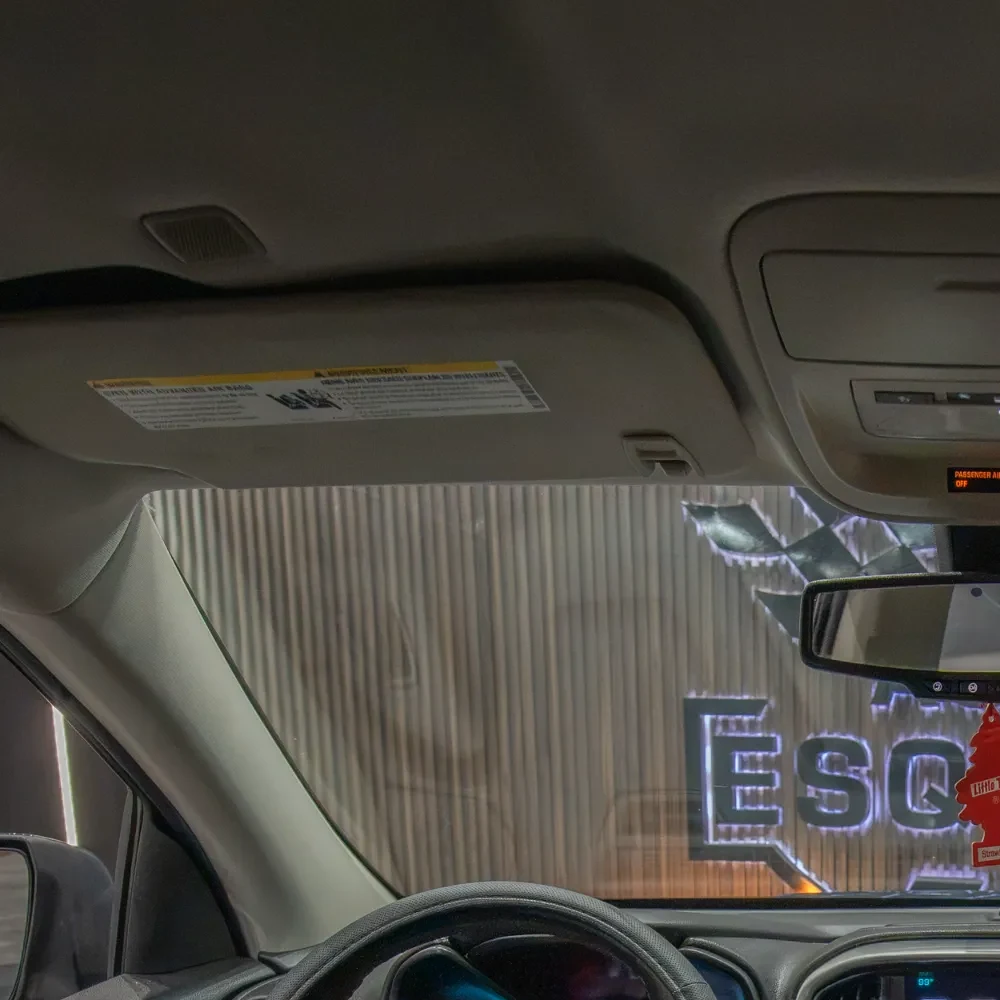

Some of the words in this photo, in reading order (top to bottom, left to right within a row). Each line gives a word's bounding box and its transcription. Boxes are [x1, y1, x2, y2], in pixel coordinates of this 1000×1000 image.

[954, 471, 991, 479] PASSENGER
[955, 480, 968, 488] OFF
[973, 781, 995, 796] Little
